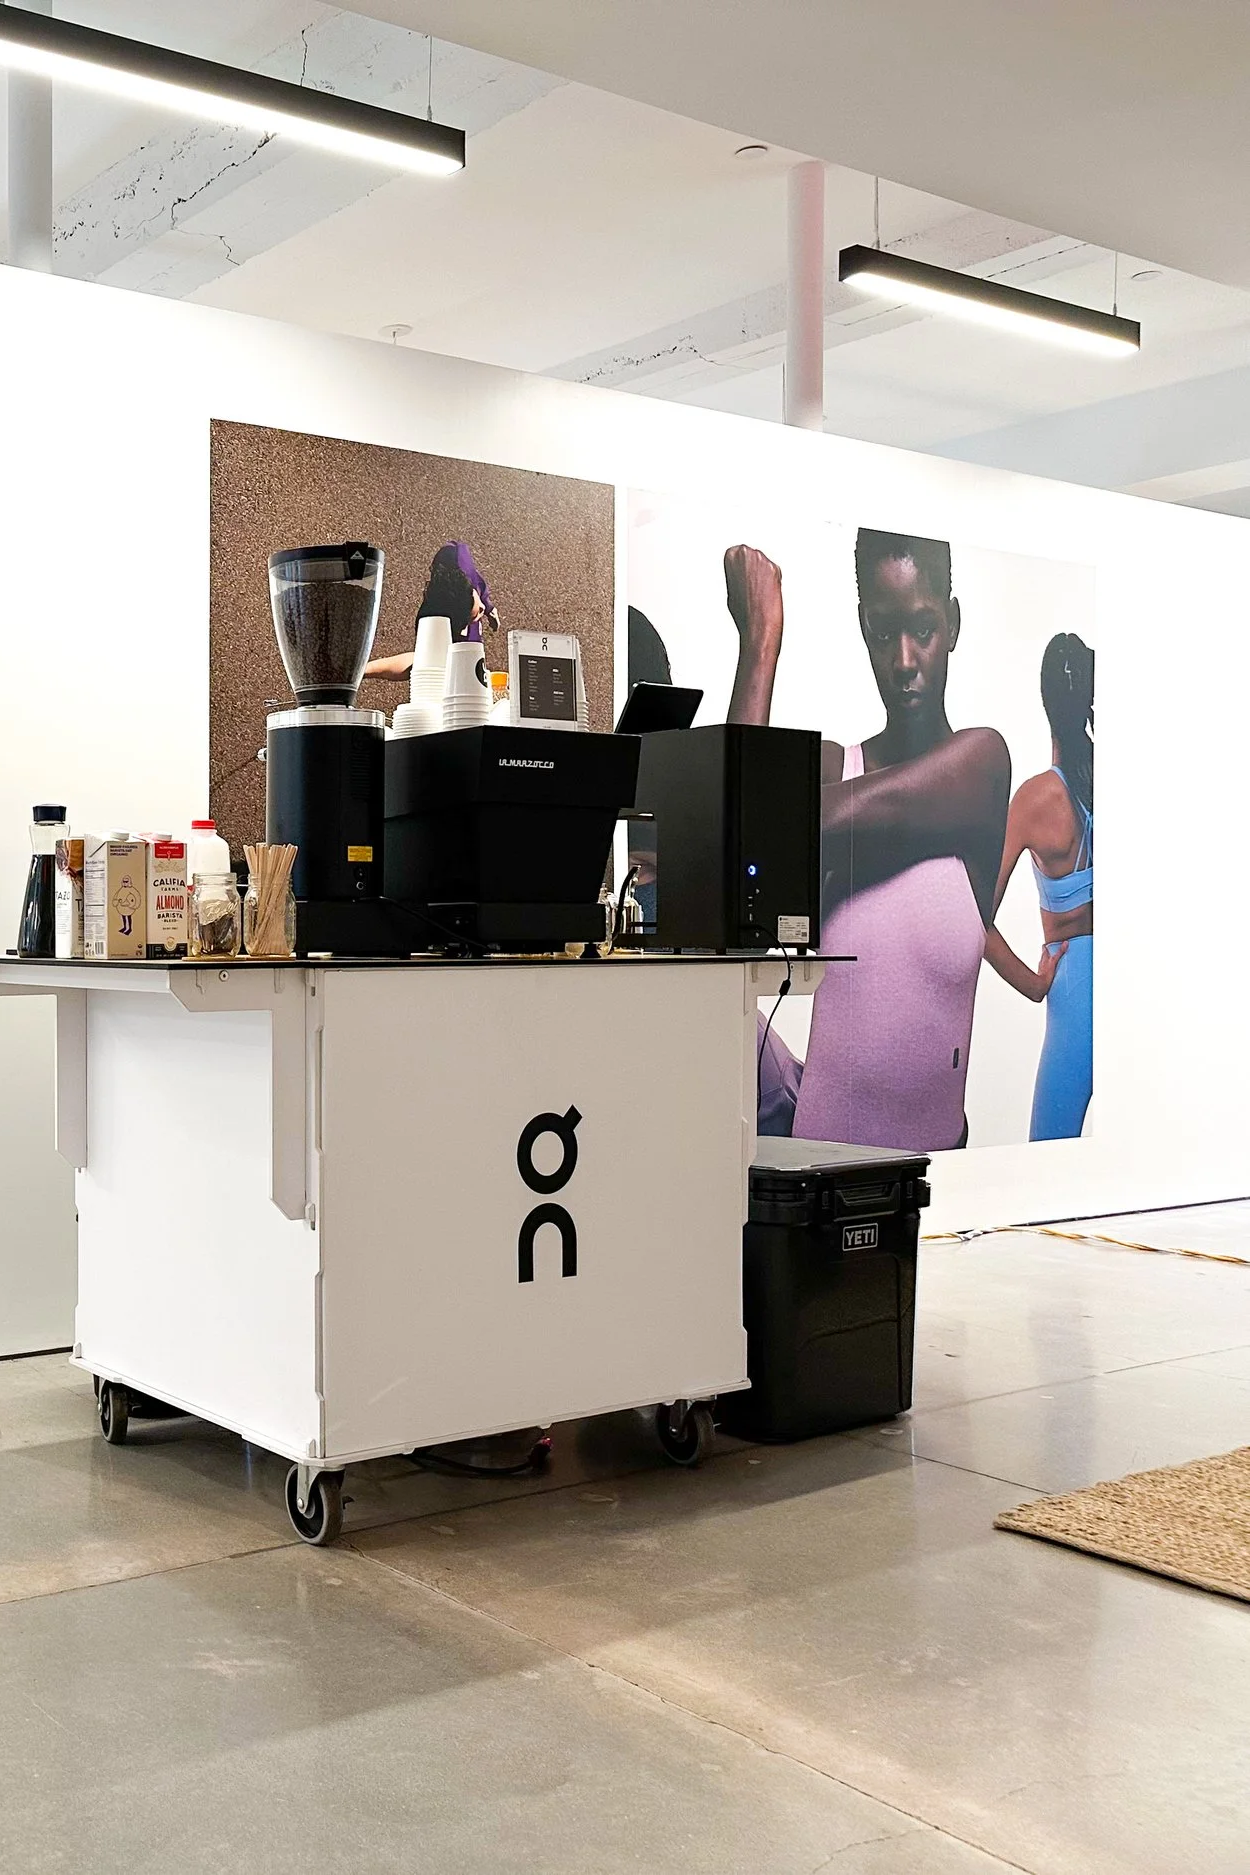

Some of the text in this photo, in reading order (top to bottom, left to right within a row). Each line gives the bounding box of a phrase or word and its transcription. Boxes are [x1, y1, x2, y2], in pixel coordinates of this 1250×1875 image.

[153, 878, 186, 887] CALIFIA
[156, 895, 184, 910] ALMOND
[845, 1229, 875, 1246] YETI
